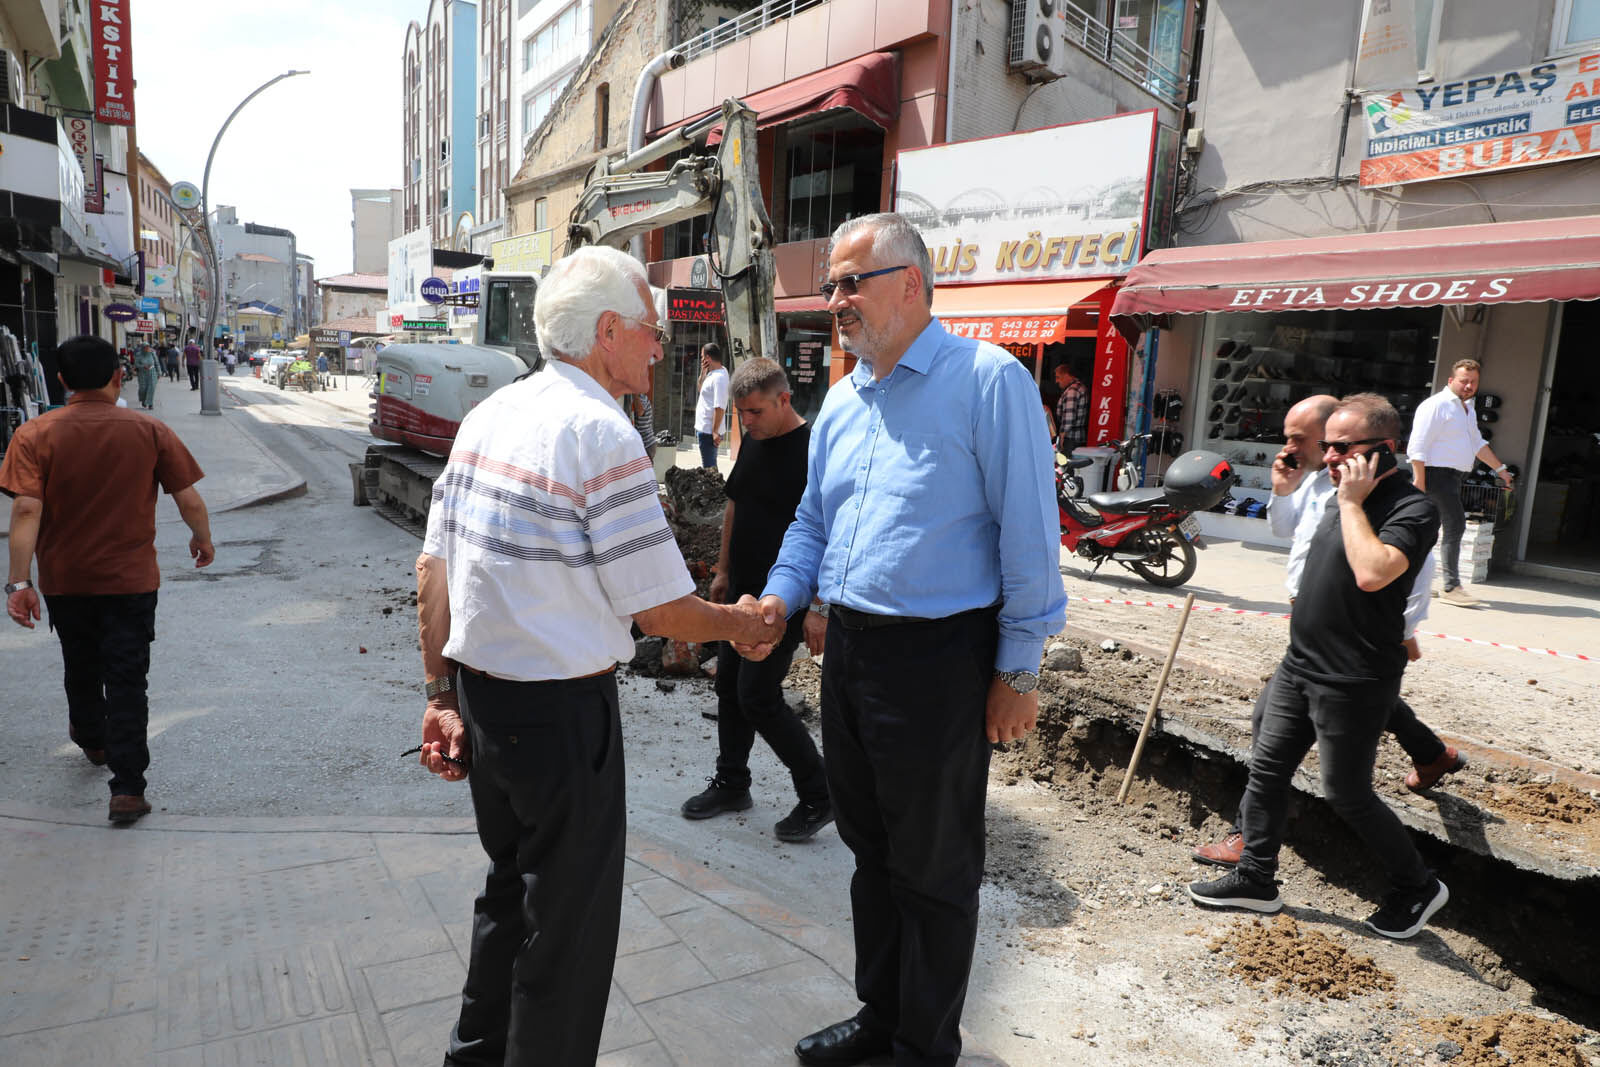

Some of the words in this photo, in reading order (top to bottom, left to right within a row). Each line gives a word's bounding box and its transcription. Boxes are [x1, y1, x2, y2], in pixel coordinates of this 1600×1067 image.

[1415, 63, 1558, 111] YEPAŞ
[1370, 131, 1440, 154] İNDİRİMLİ
[1445, 116, 1528, 143] ELEKTRİK
[996, 222, 1140, 271] KÖFTECİ
[1230, 286, 1326, 306] EFTA
[1343, 278, 1514, 304] SHOES
[999, 330, 1019, 338] 542
[1039, 329, 1055, 338] 20
[1001, 321, 1022, 329] 543
[1043, 320, 1059, 328] 20
